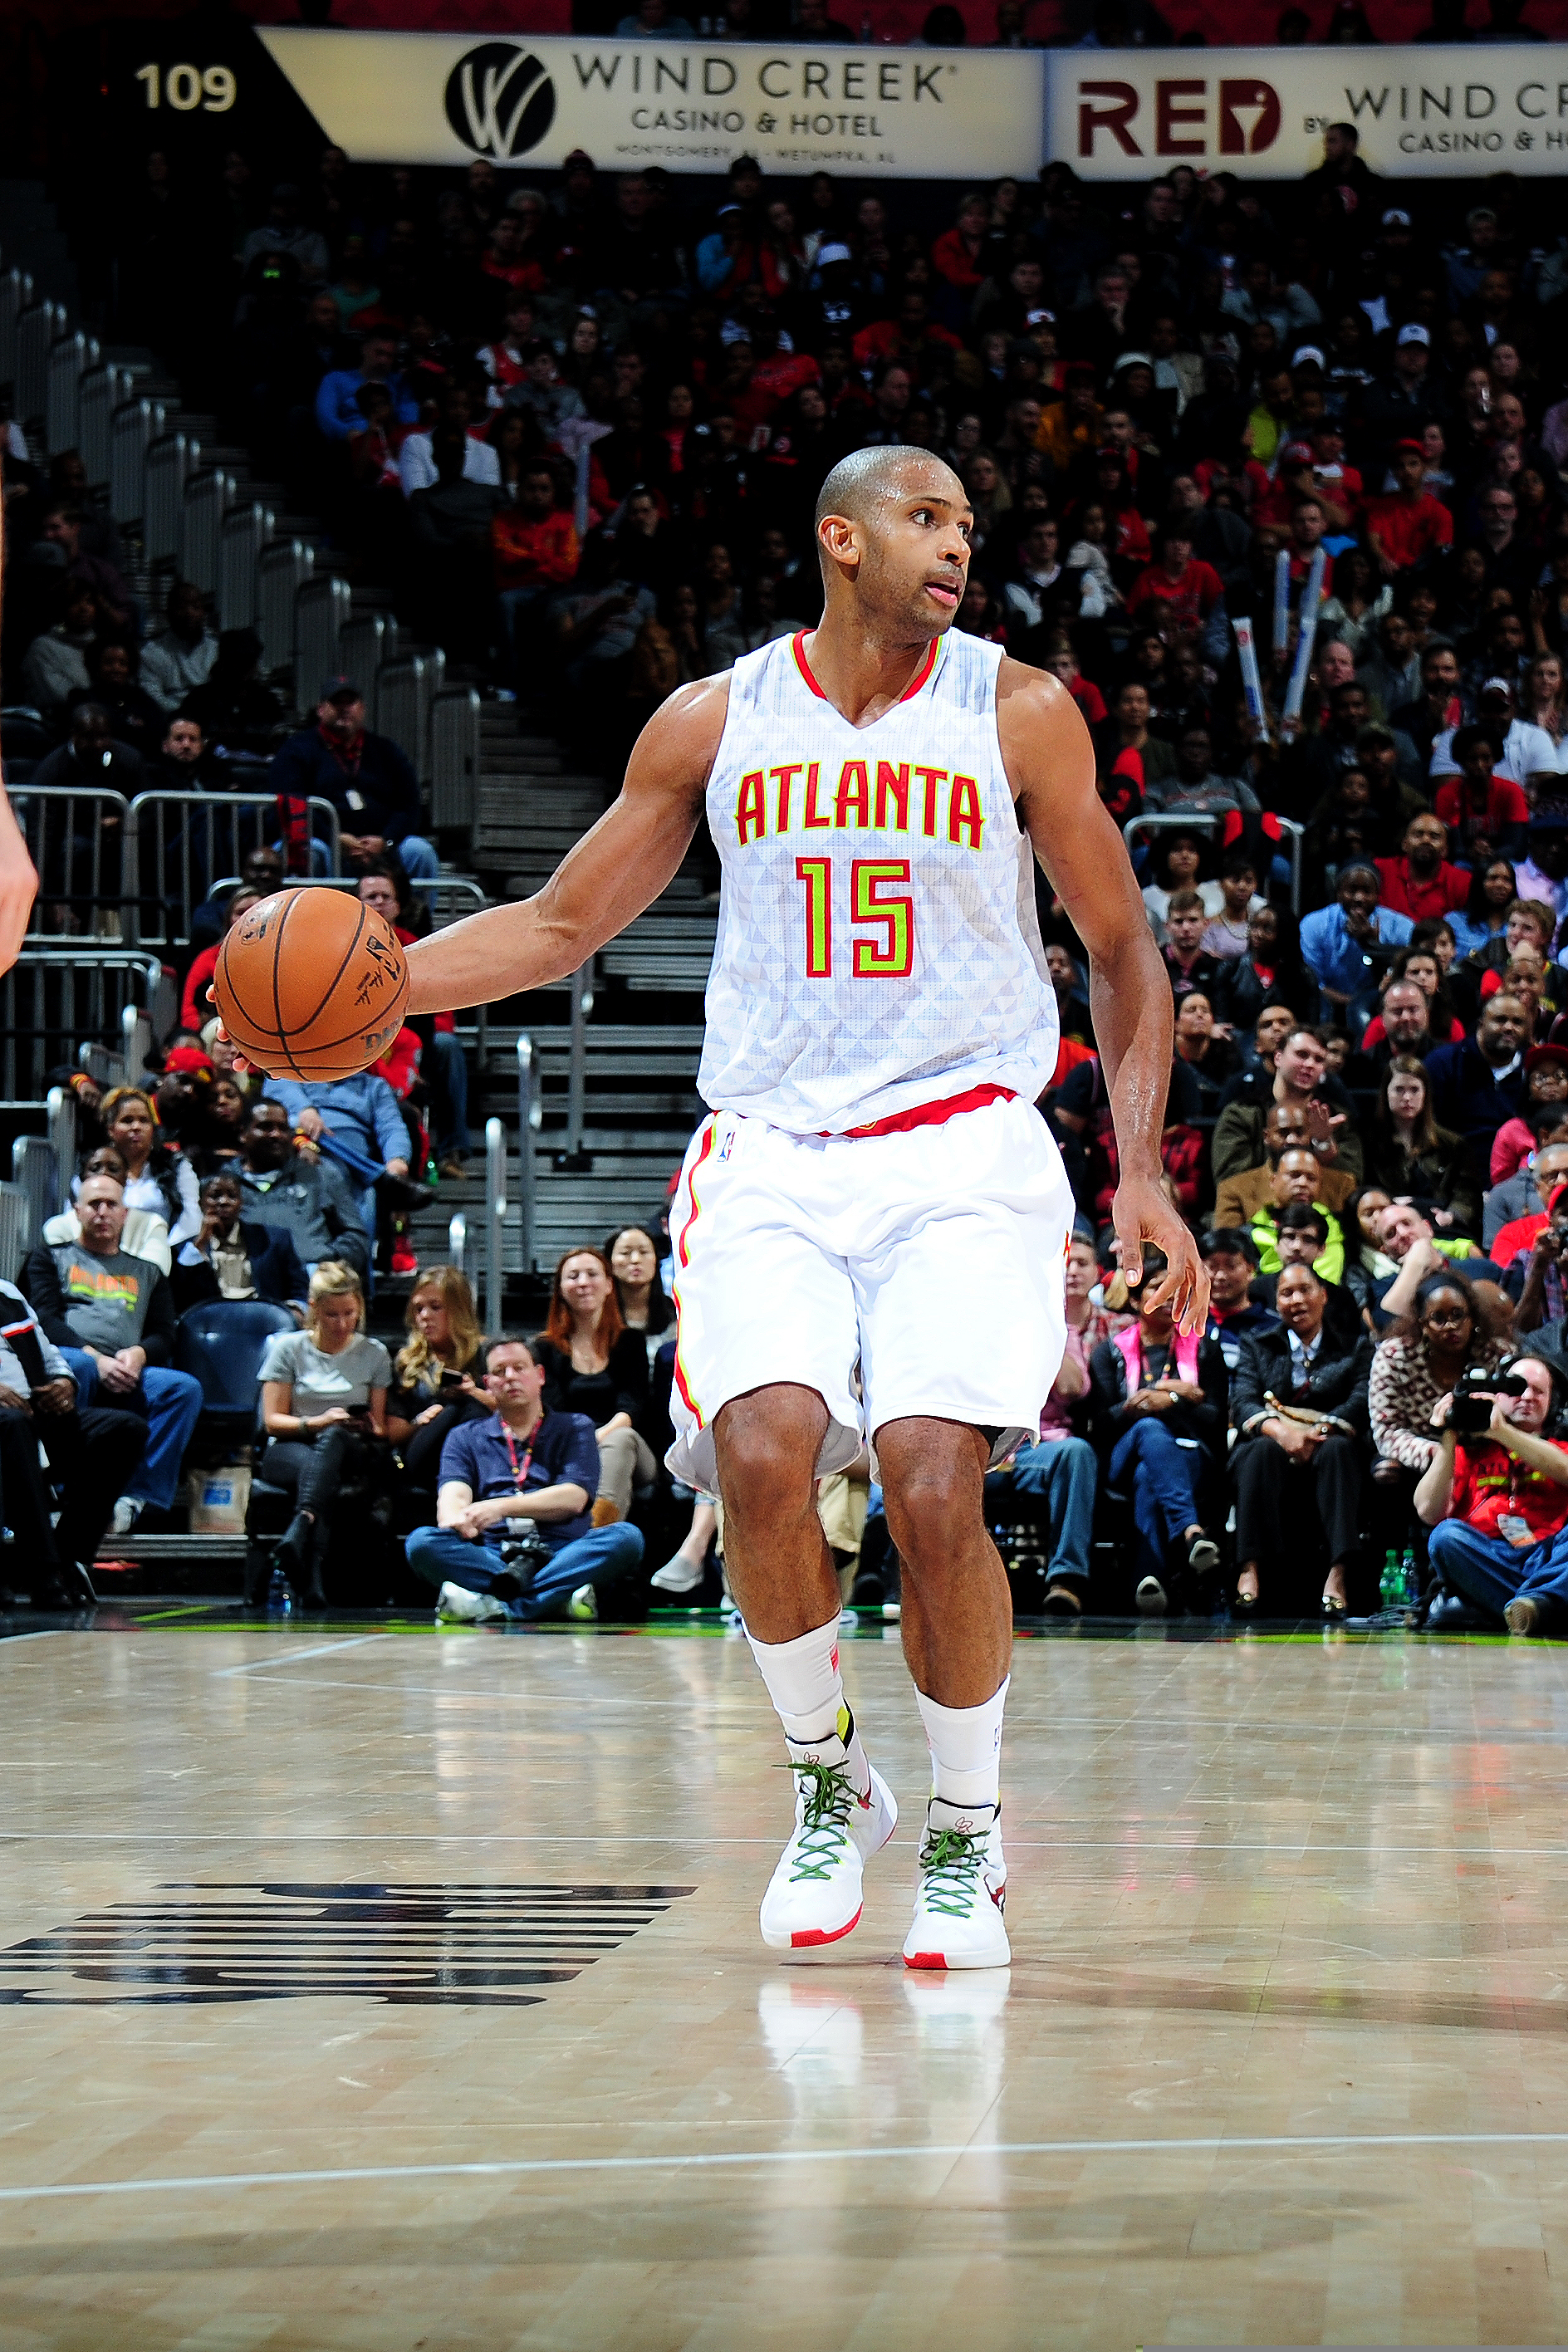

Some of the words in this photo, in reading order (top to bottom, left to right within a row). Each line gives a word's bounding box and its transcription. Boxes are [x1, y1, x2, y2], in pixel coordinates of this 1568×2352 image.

[135, 63, 236, 112] 109
[572, 54, 737, 97] WIND
[631, 109, 744, 133] CASINO
[757, 111, 777, 135] &
[790, 113, 882, 137] HOTEL
[1078, 79, 1281, 158] RED
[1345, 85, 1495, 120] WIND
[1399, 128, 1503, 154] CASINO
[1514, 130, 1535, 151] &
[735, 759, 987, 852] ATLANTA
[795, 856, 914, 978] 15
